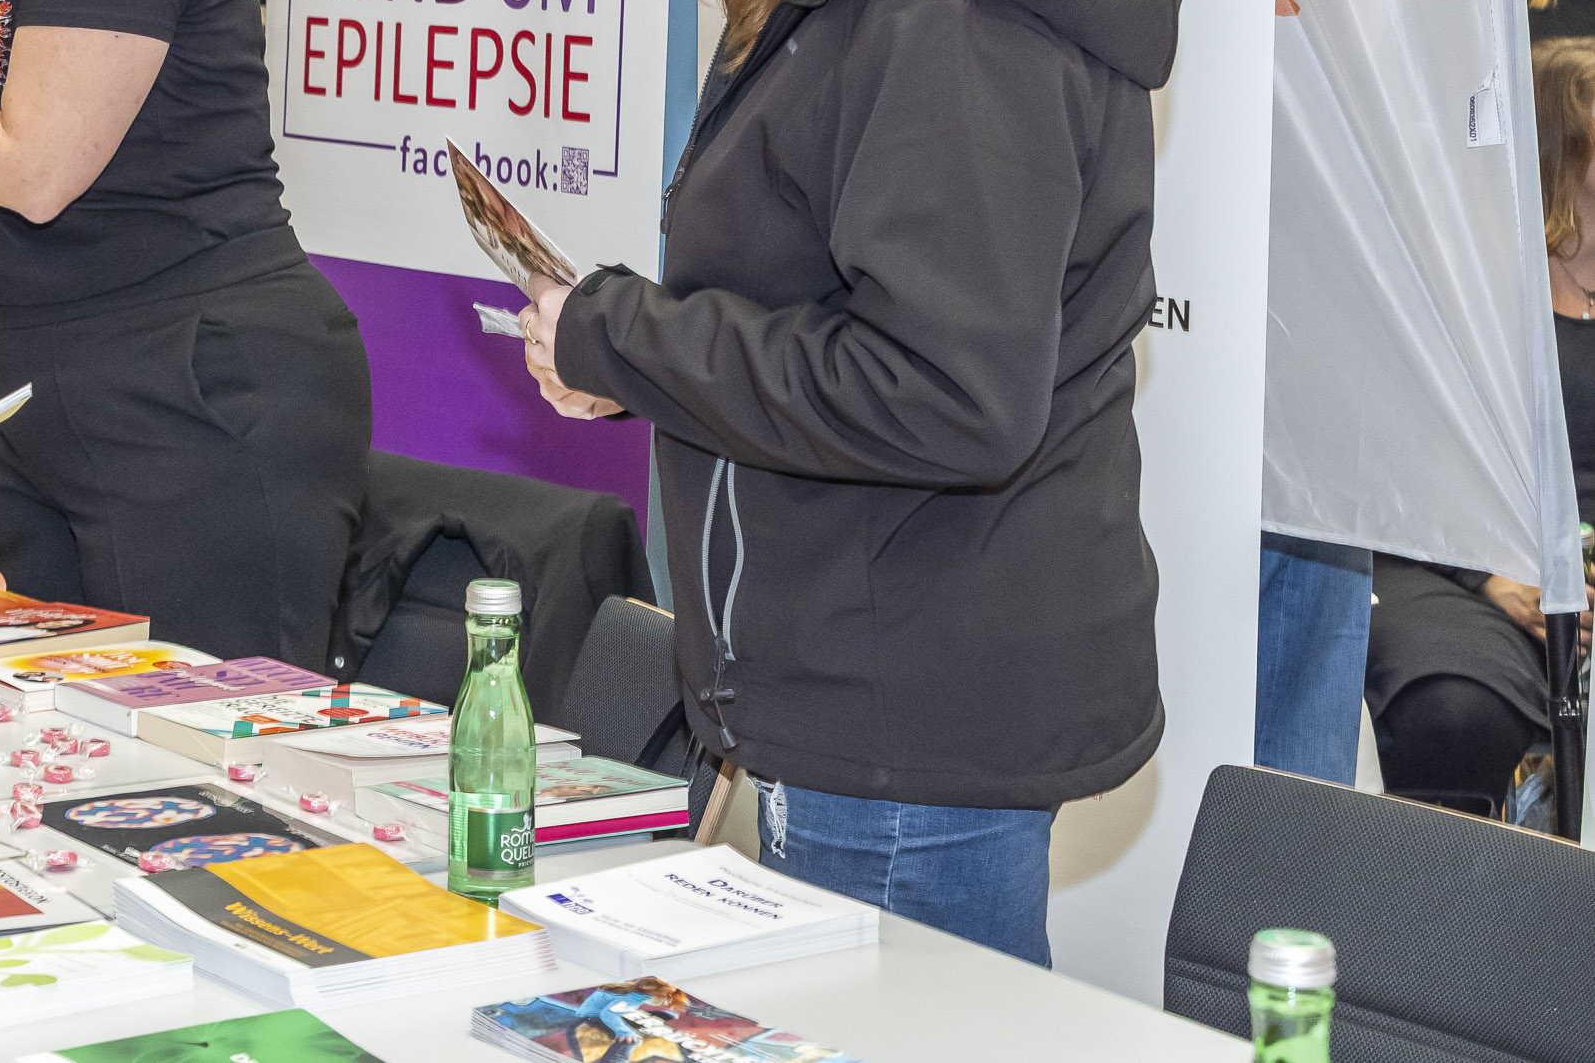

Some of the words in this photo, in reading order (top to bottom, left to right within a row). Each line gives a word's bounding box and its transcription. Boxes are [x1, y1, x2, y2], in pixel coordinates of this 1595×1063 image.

[303, 16, 594, 123] EPILEPSIE
[400, 136, 558, 192] facbook:
[663, 873, 716, 898] REDEN
[716, 897, 784, 921] KÖNNEN
[224, 901, 336, 955] Wissens-Wert
